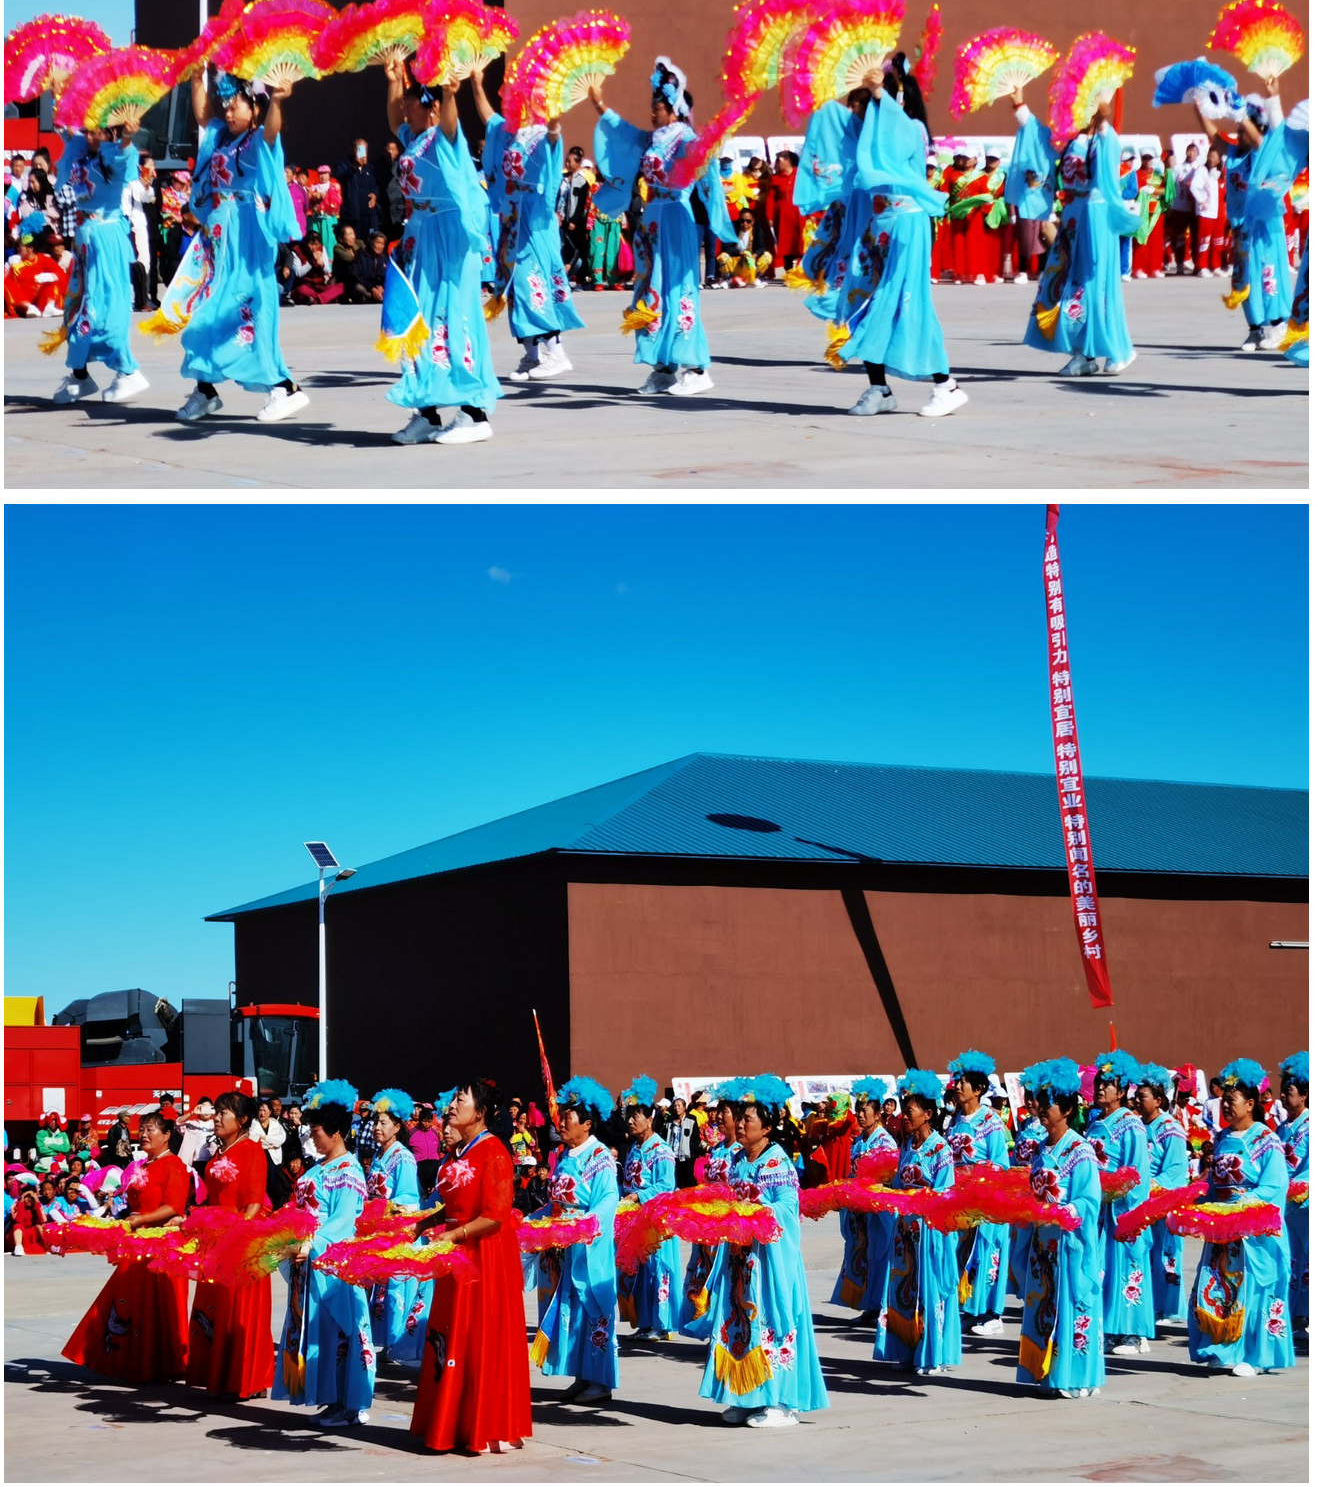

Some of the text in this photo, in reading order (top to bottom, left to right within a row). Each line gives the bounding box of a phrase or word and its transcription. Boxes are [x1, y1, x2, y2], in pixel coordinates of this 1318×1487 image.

[1052, 670, 1074, 738] 特别宜居
[1056, 742, 1083, 809] 特别宜业
[1064, 813, 1102, 960] 特别闻名的美丽乡村
